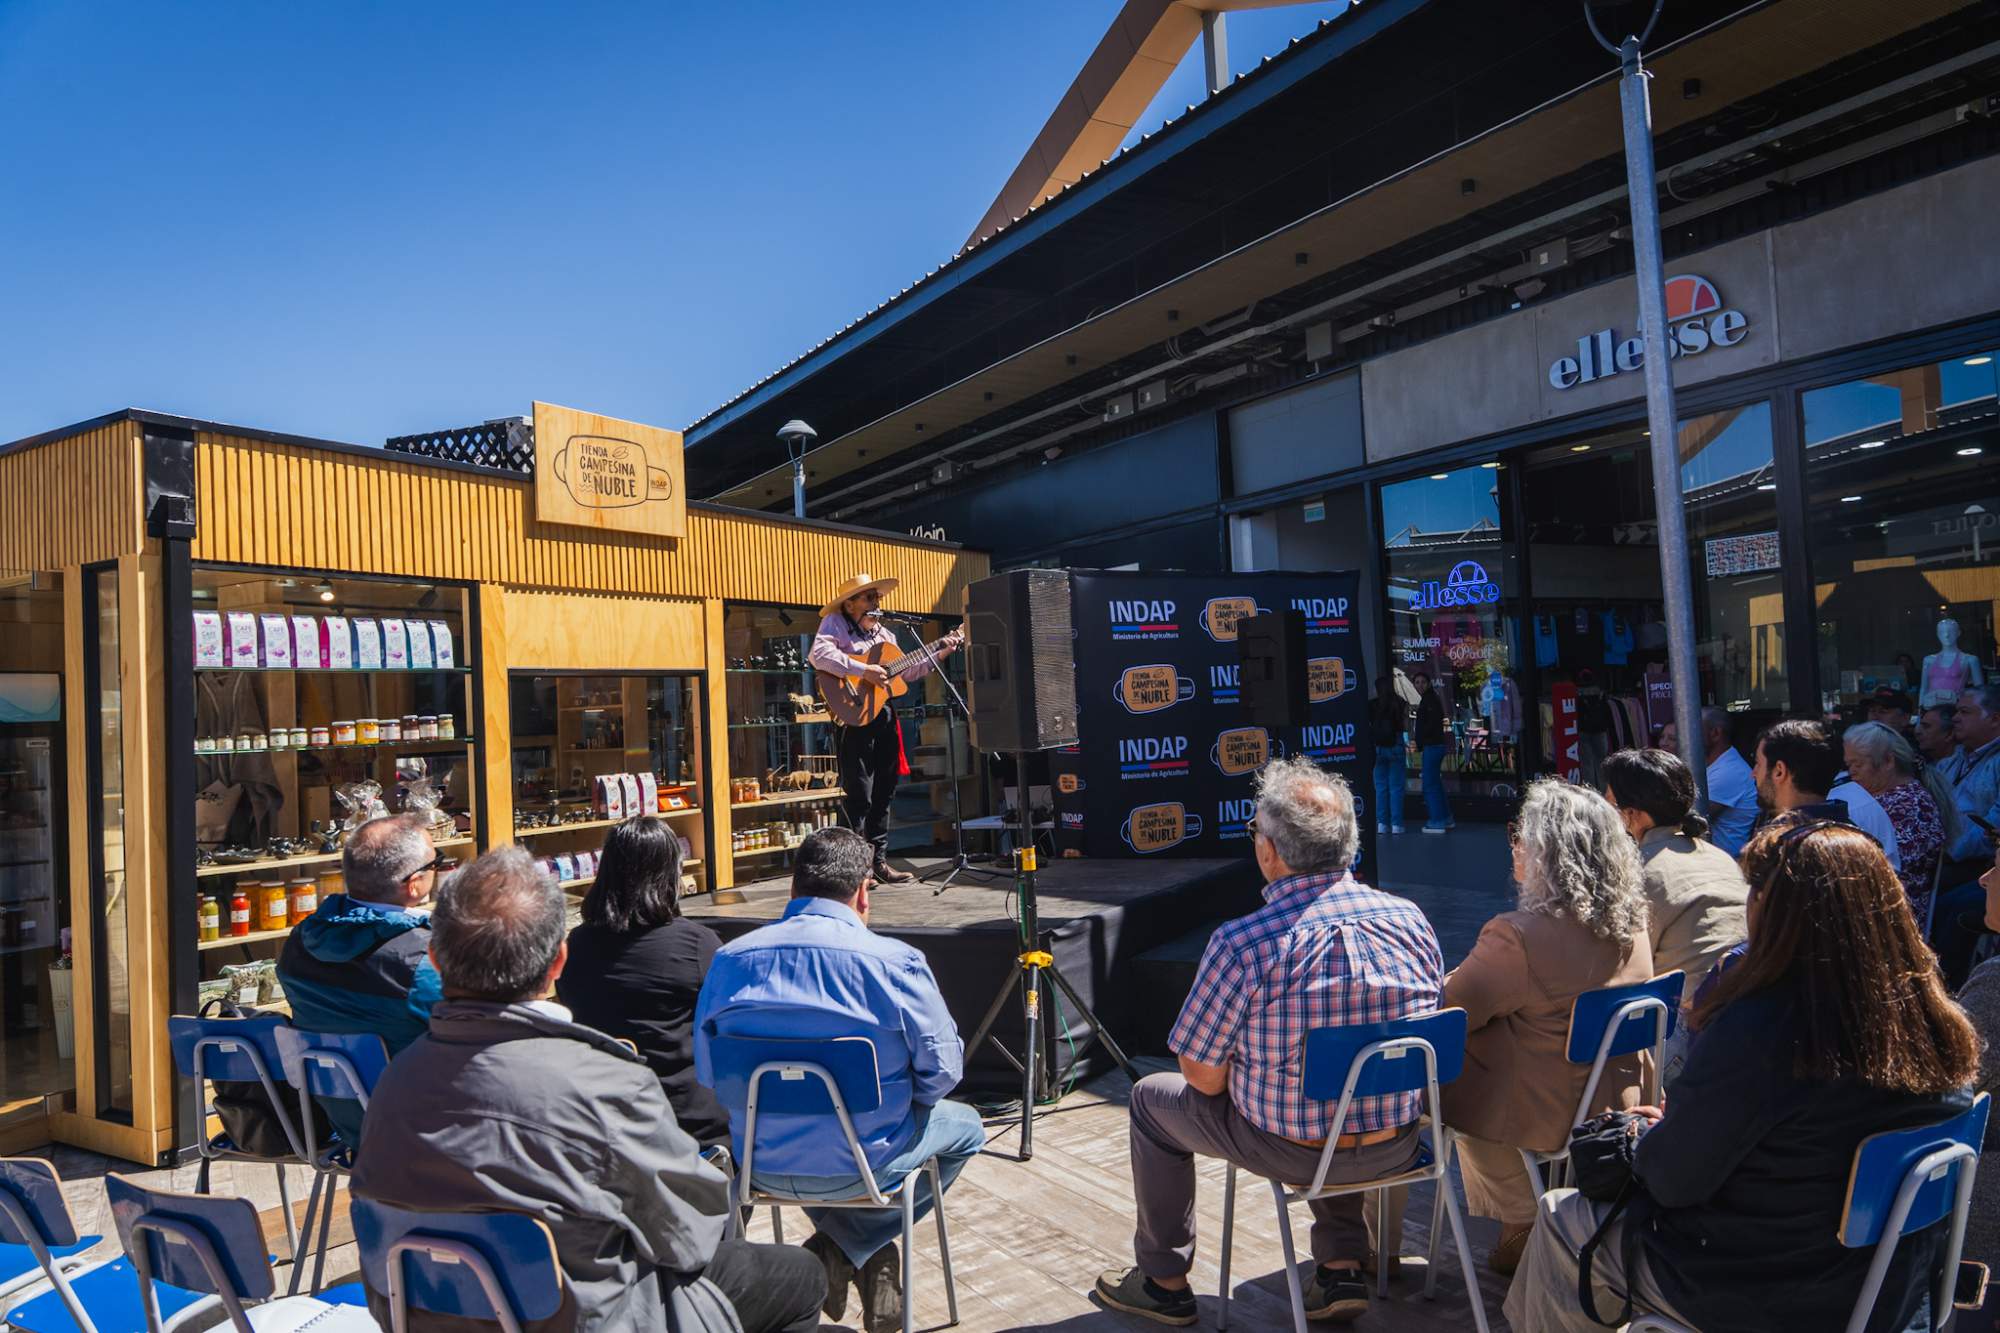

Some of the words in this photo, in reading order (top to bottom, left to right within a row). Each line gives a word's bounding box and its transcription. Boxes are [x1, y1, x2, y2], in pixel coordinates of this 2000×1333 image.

[581, 443, 608, 458] TIENDA
[580, 455, 636, 477] CAMPESINA
[582, 471, 592, 484] DE
[1408, 580, 1501, 610] ellesse
[1108, 599, 1177, 623] INDAP
[1402, 637, 1441, 649] SUMMER
[1402, 651, 1425, 662] SALE
[1131, 679, 1170, 691] CAMPESINA
[1301, 722, 1355, 748] INDAP
[1561, 697, 1581, 785] SALE
[1119, 735, 1188, 763] INDAP
[1226, 741, 1261, 753] CAMPESINA
[1218, 798, 1256, 823] IND
[1138, 816, 1177, 830] CAMPESINA
